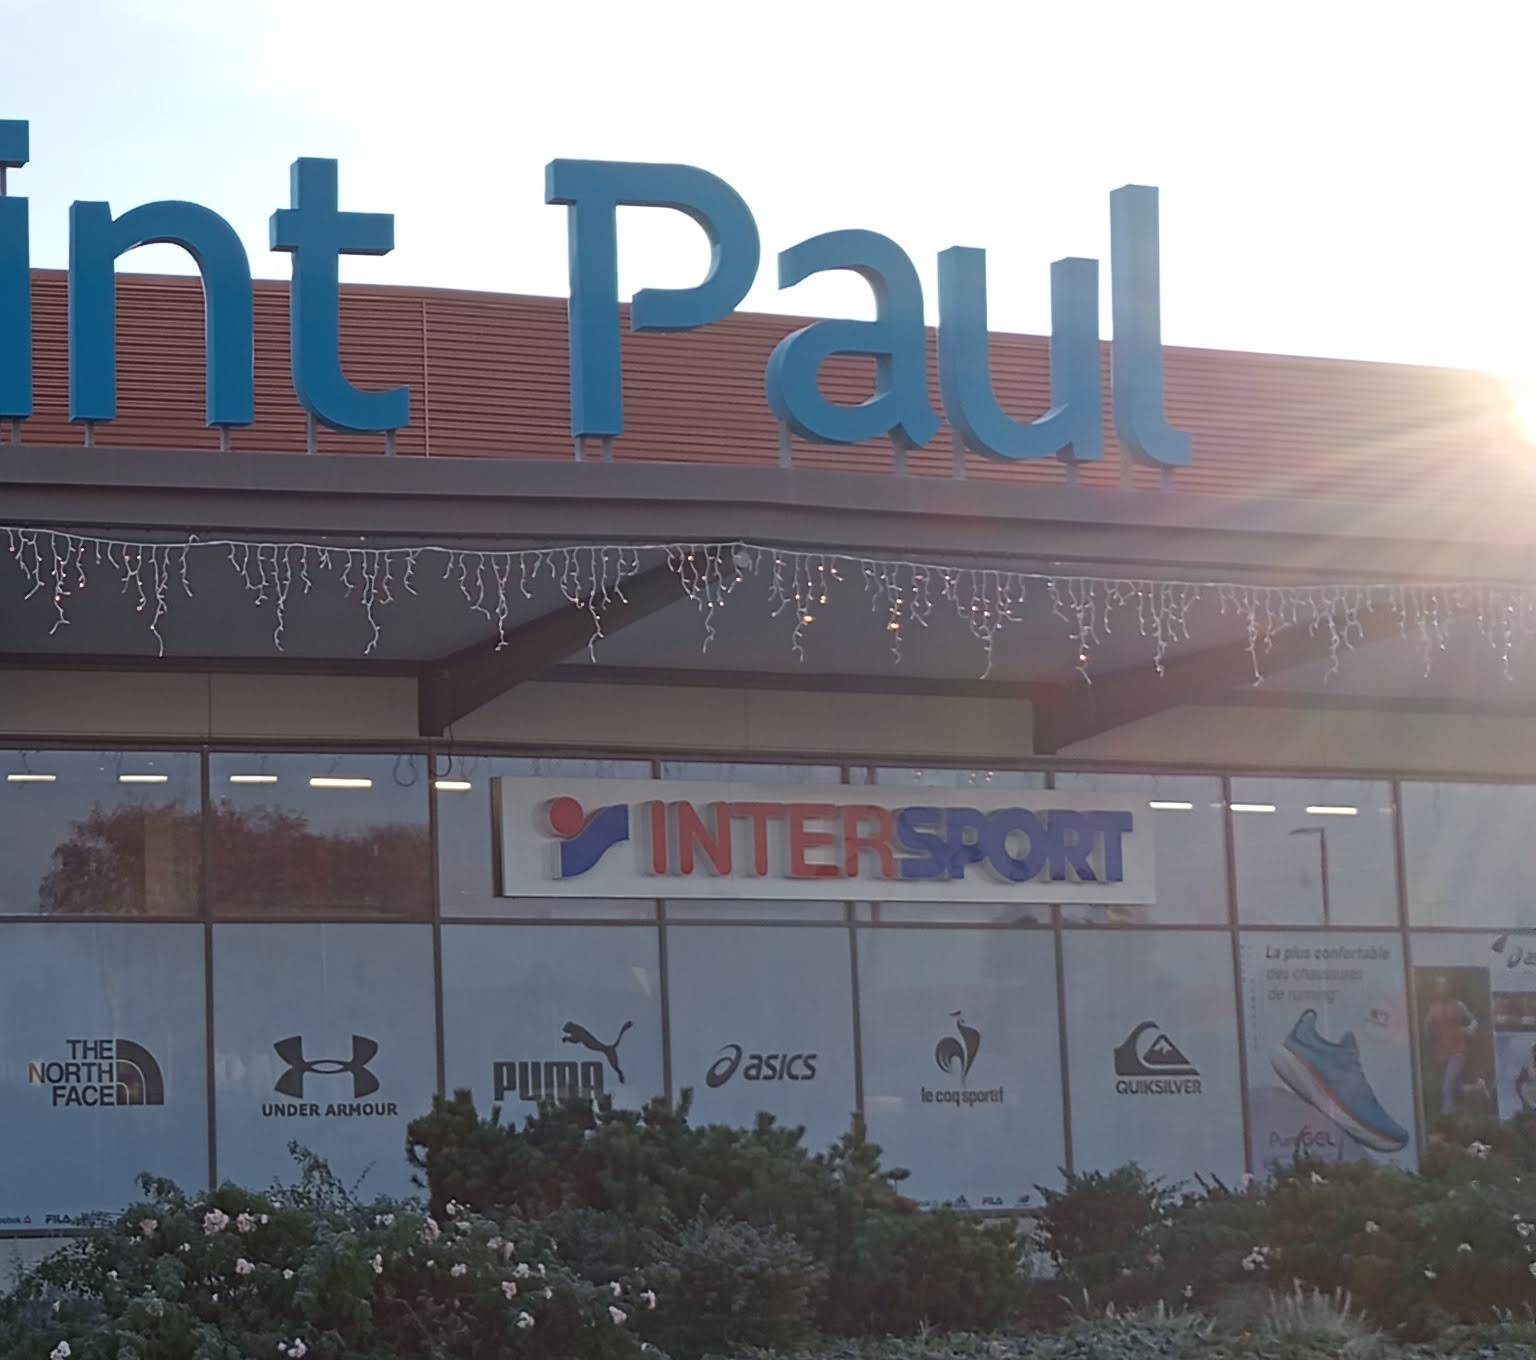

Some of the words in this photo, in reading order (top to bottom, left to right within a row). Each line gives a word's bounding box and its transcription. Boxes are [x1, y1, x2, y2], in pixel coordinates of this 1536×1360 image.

[544, 157, 1192, 469] Paul
[644, 799, 1134, 884] INTERSPORT
[66, 1040, 113, 1059] THE
[28, 1063, 114, 1083] NORTH
[52, 1086, 115, 1106] FACE
[1115, 1079, 1203, 1095] QUIKSILVER
[921, 1087, 933, 1103] le
[935, 1090, 961, 1108] coq
[262, 1104, 320, 1117] UNDER
[325, 1103, 398, 1117] ARMOUR
